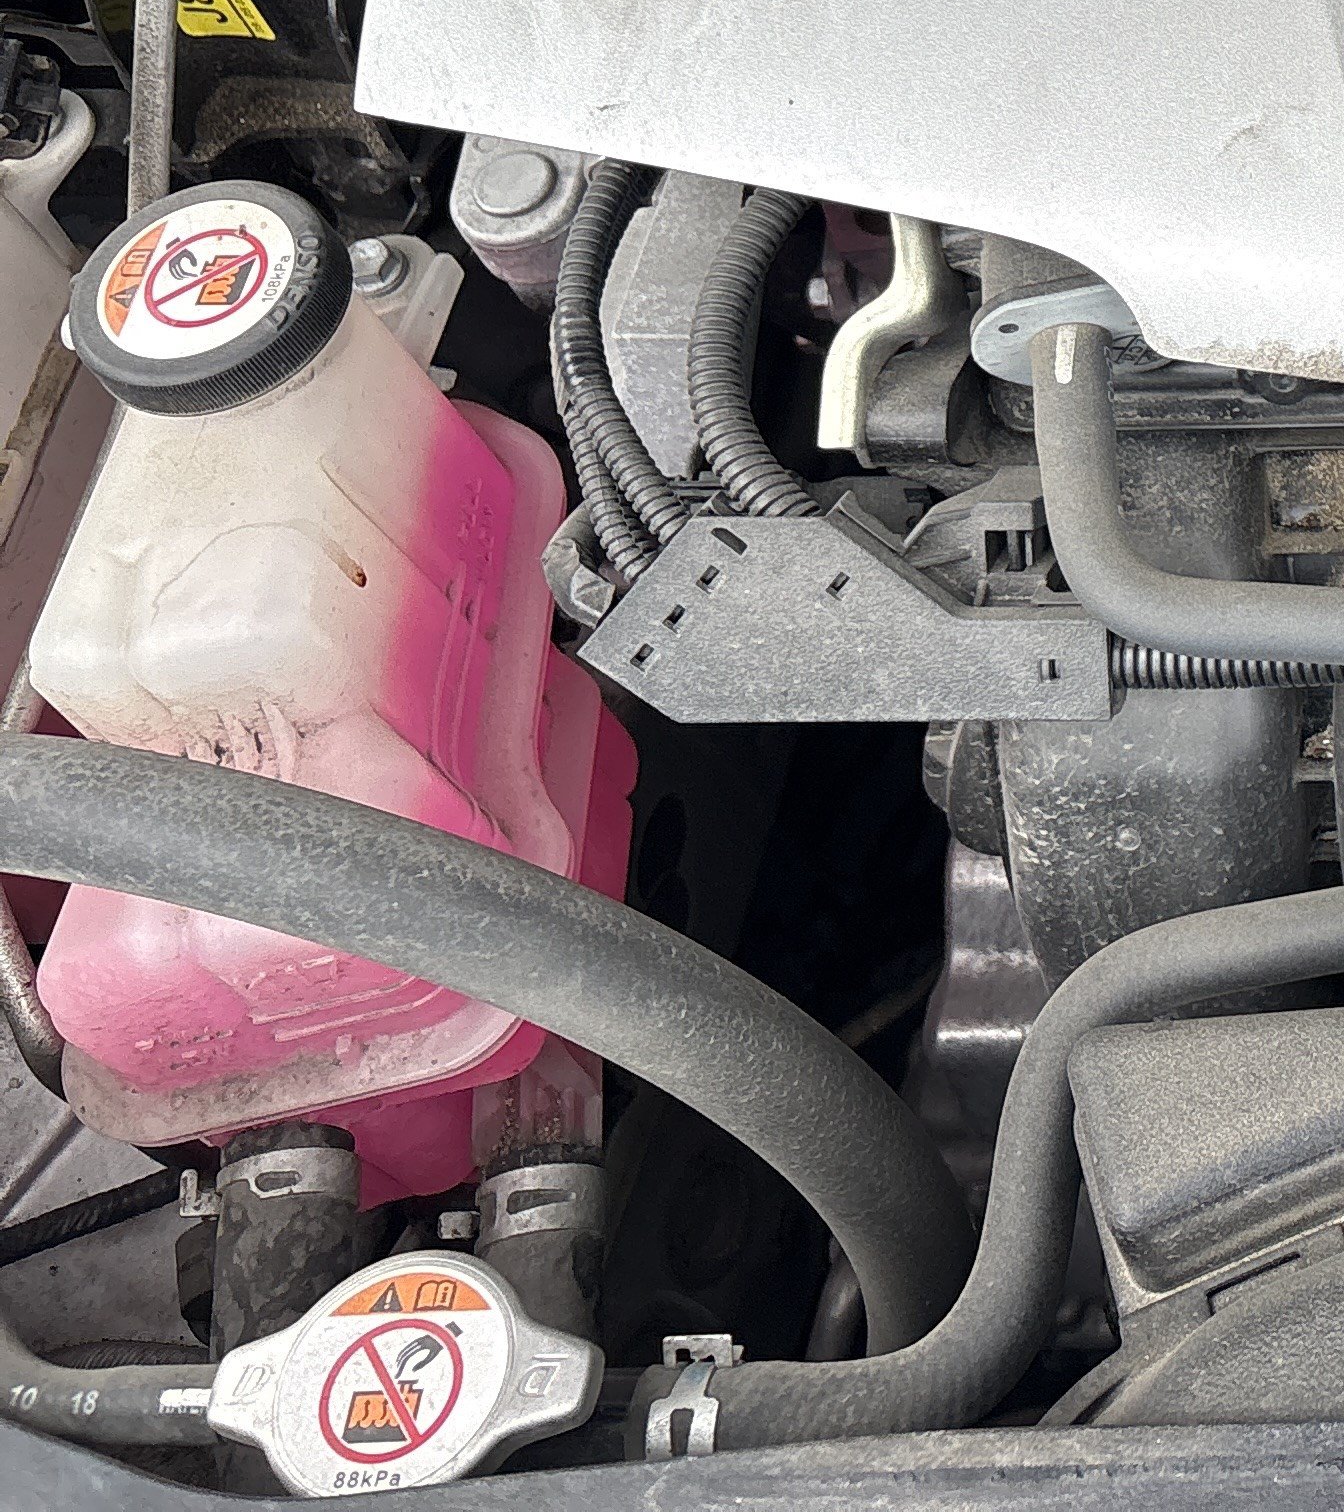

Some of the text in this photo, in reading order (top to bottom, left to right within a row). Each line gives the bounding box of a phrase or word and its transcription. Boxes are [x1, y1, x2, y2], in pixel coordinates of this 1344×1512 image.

[261, 254, 292, 303] 108kPa
[267, 233, 321, 332] DENSO
[10, 1383, 100, 1416] 10 18
[333, 1469, 401, 1489] 88kPa
